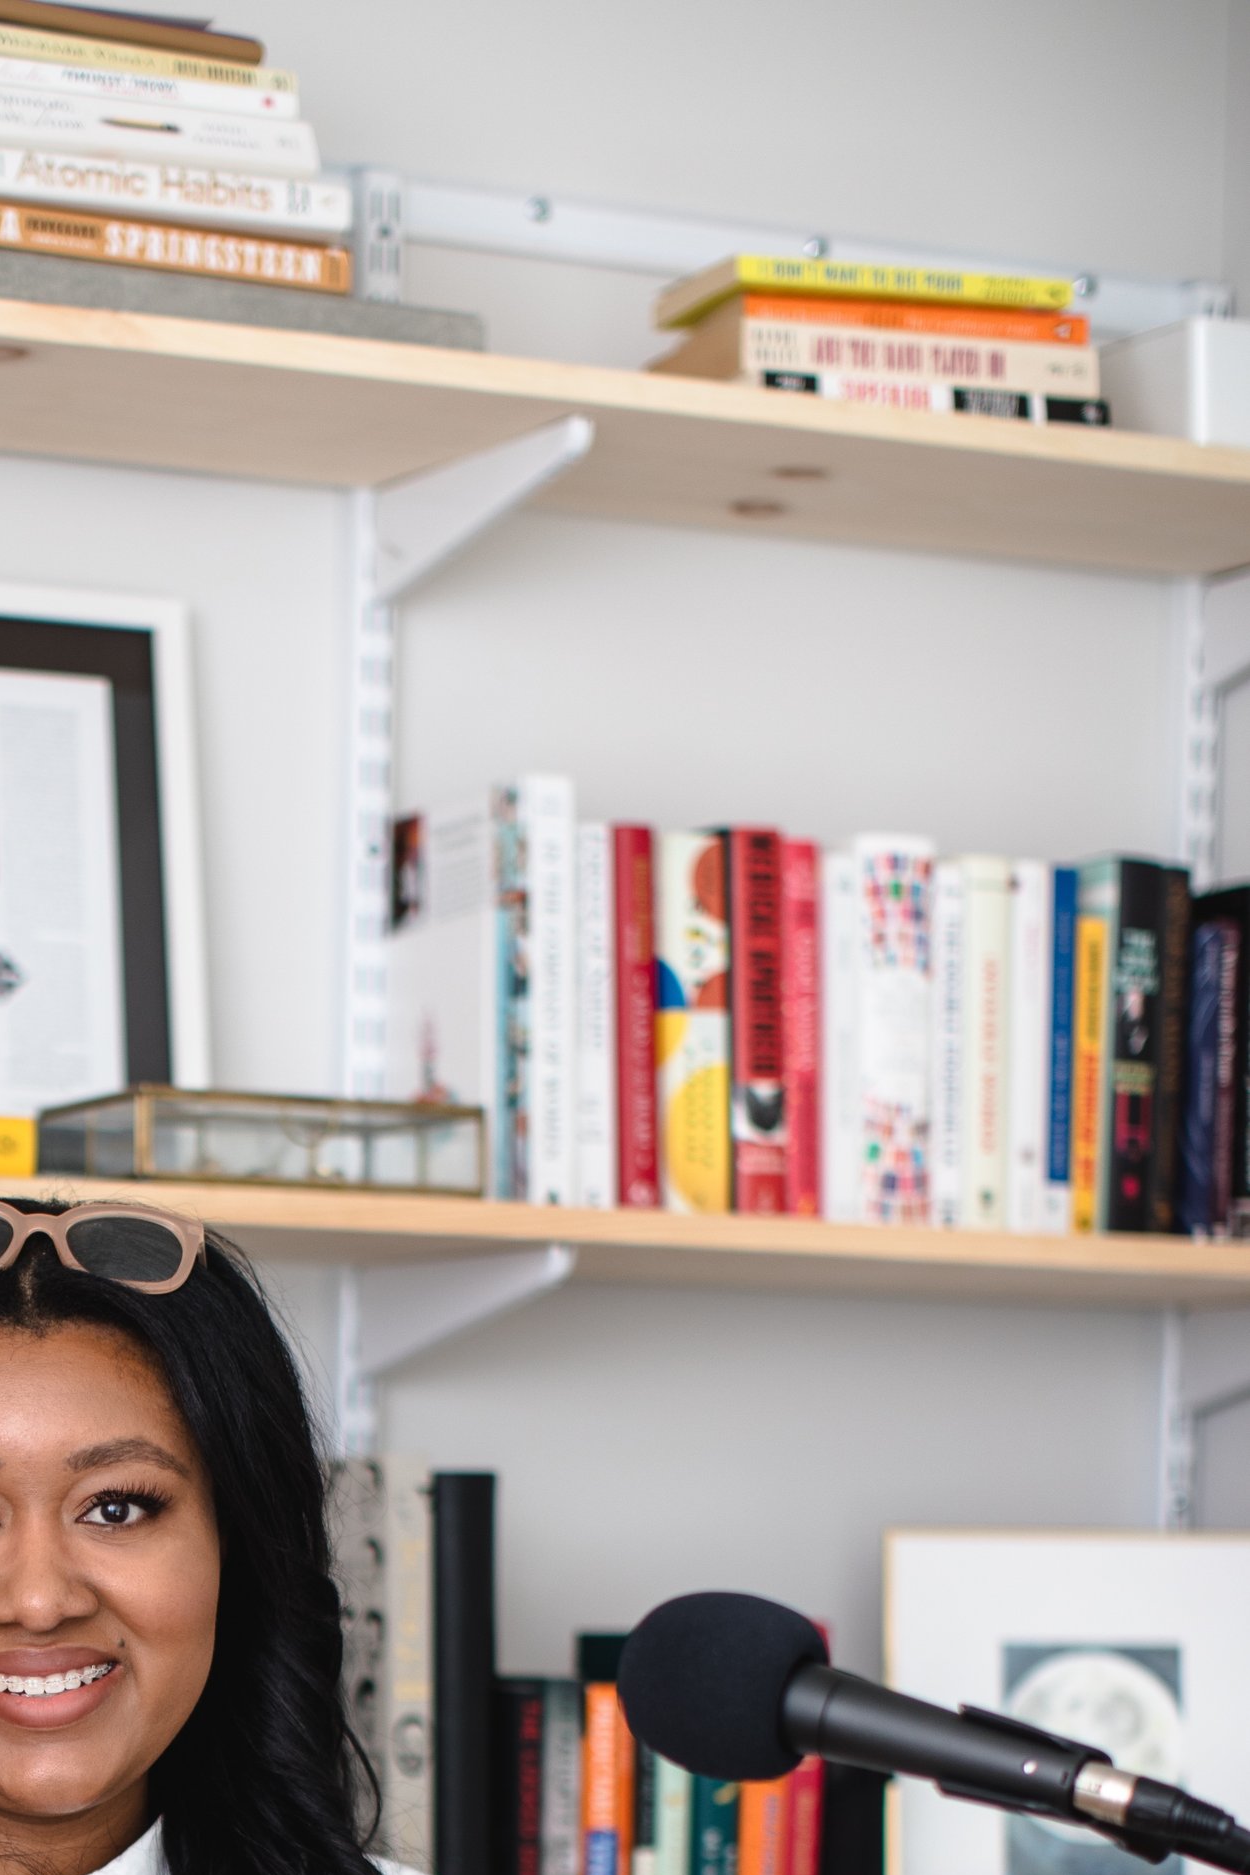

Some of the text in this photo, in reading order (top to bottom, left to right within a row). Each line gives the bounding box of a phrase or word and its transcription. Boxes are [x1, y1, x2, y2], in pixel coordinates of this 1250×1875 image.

[14, 153, 146, 198] Atomic
[158, 167, 274, 213] Habits
[103, 222, 323, 283] SPRINGSTEEN
